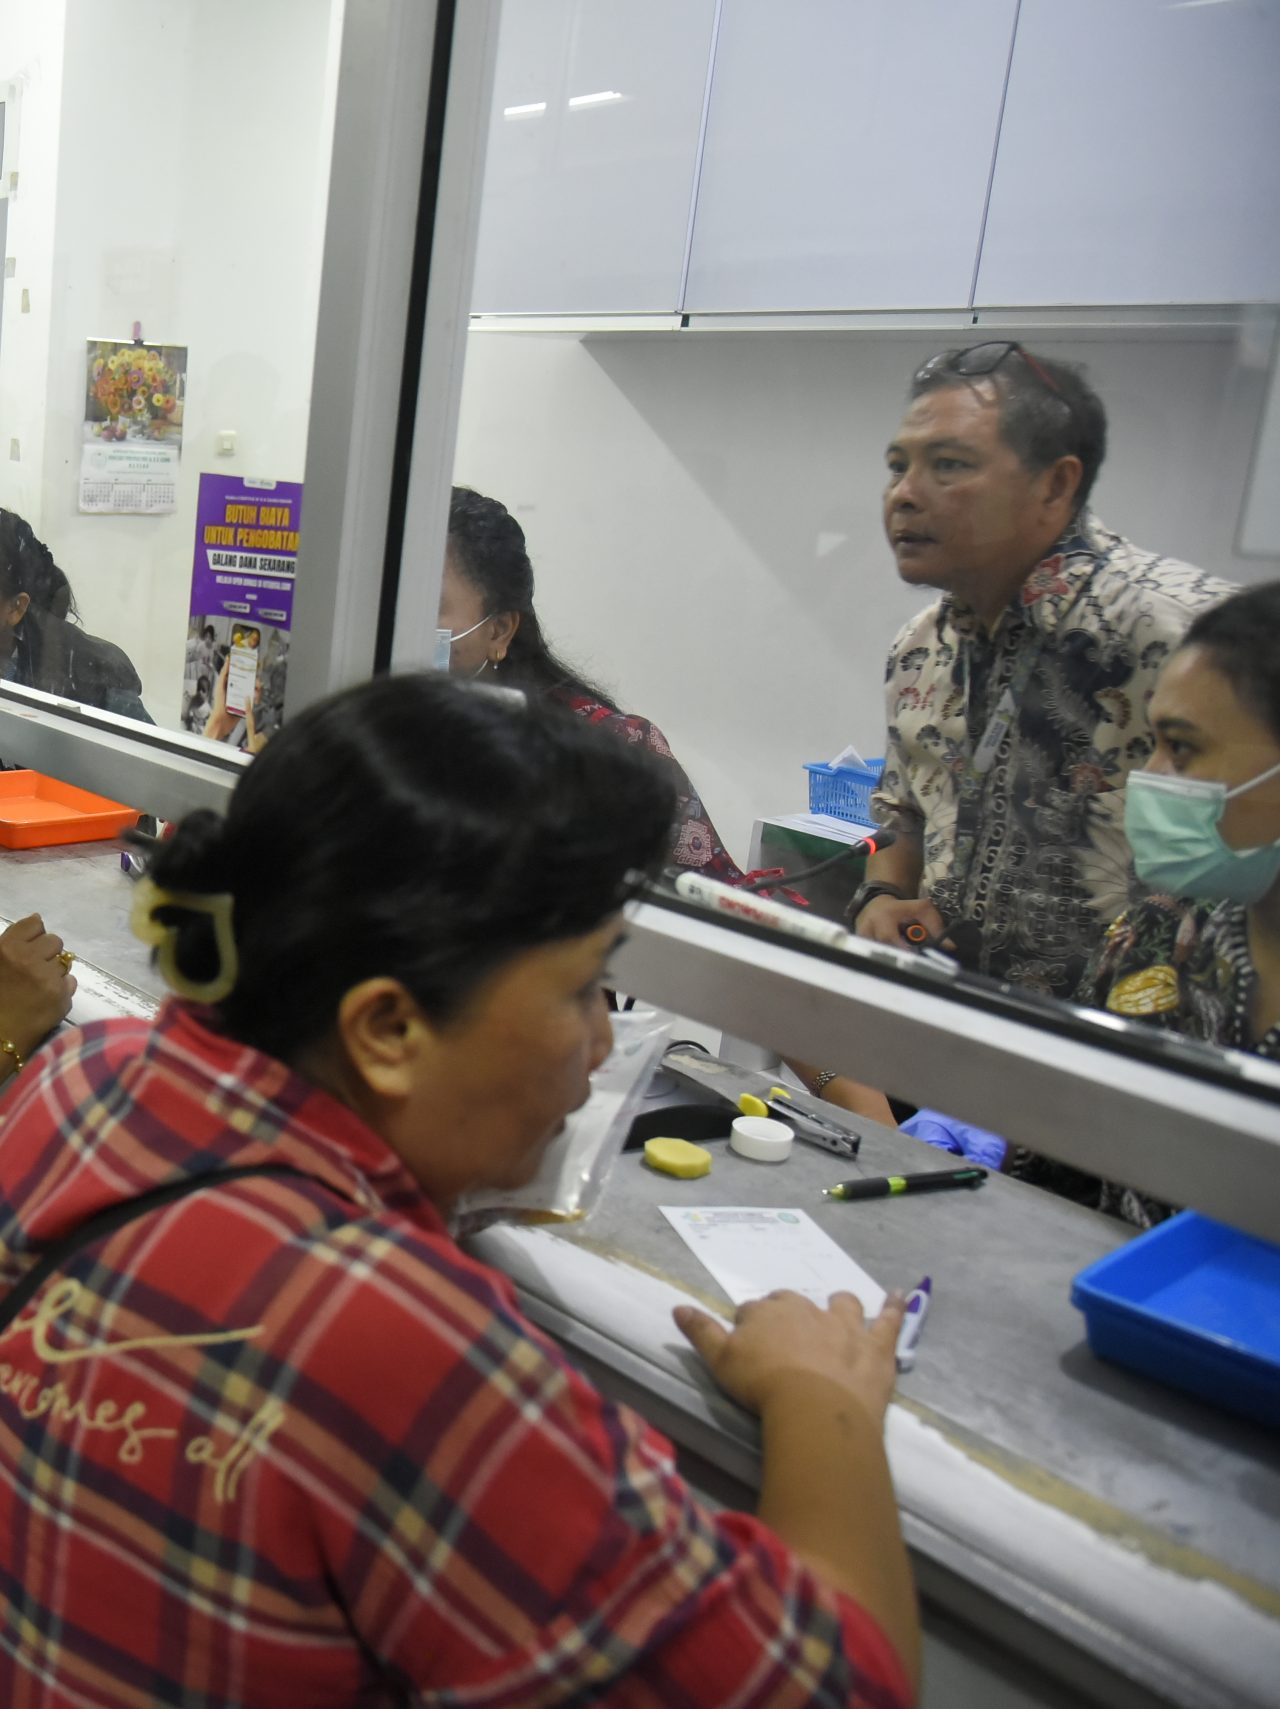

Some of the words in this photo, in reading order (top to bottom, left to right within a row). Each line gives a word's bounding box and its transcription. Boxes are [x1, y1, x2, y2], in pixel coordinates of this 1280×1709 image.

[225, 504, 257, 524] BUTUH
[260, 506, 289, 527] BIAYA
[204, 525, 235, 546] UNTUK
[212, 553, 237, 567] GALANG
[239, 556, 257, 569] DANA
[259, 557, 295, 574] SEKARANG
